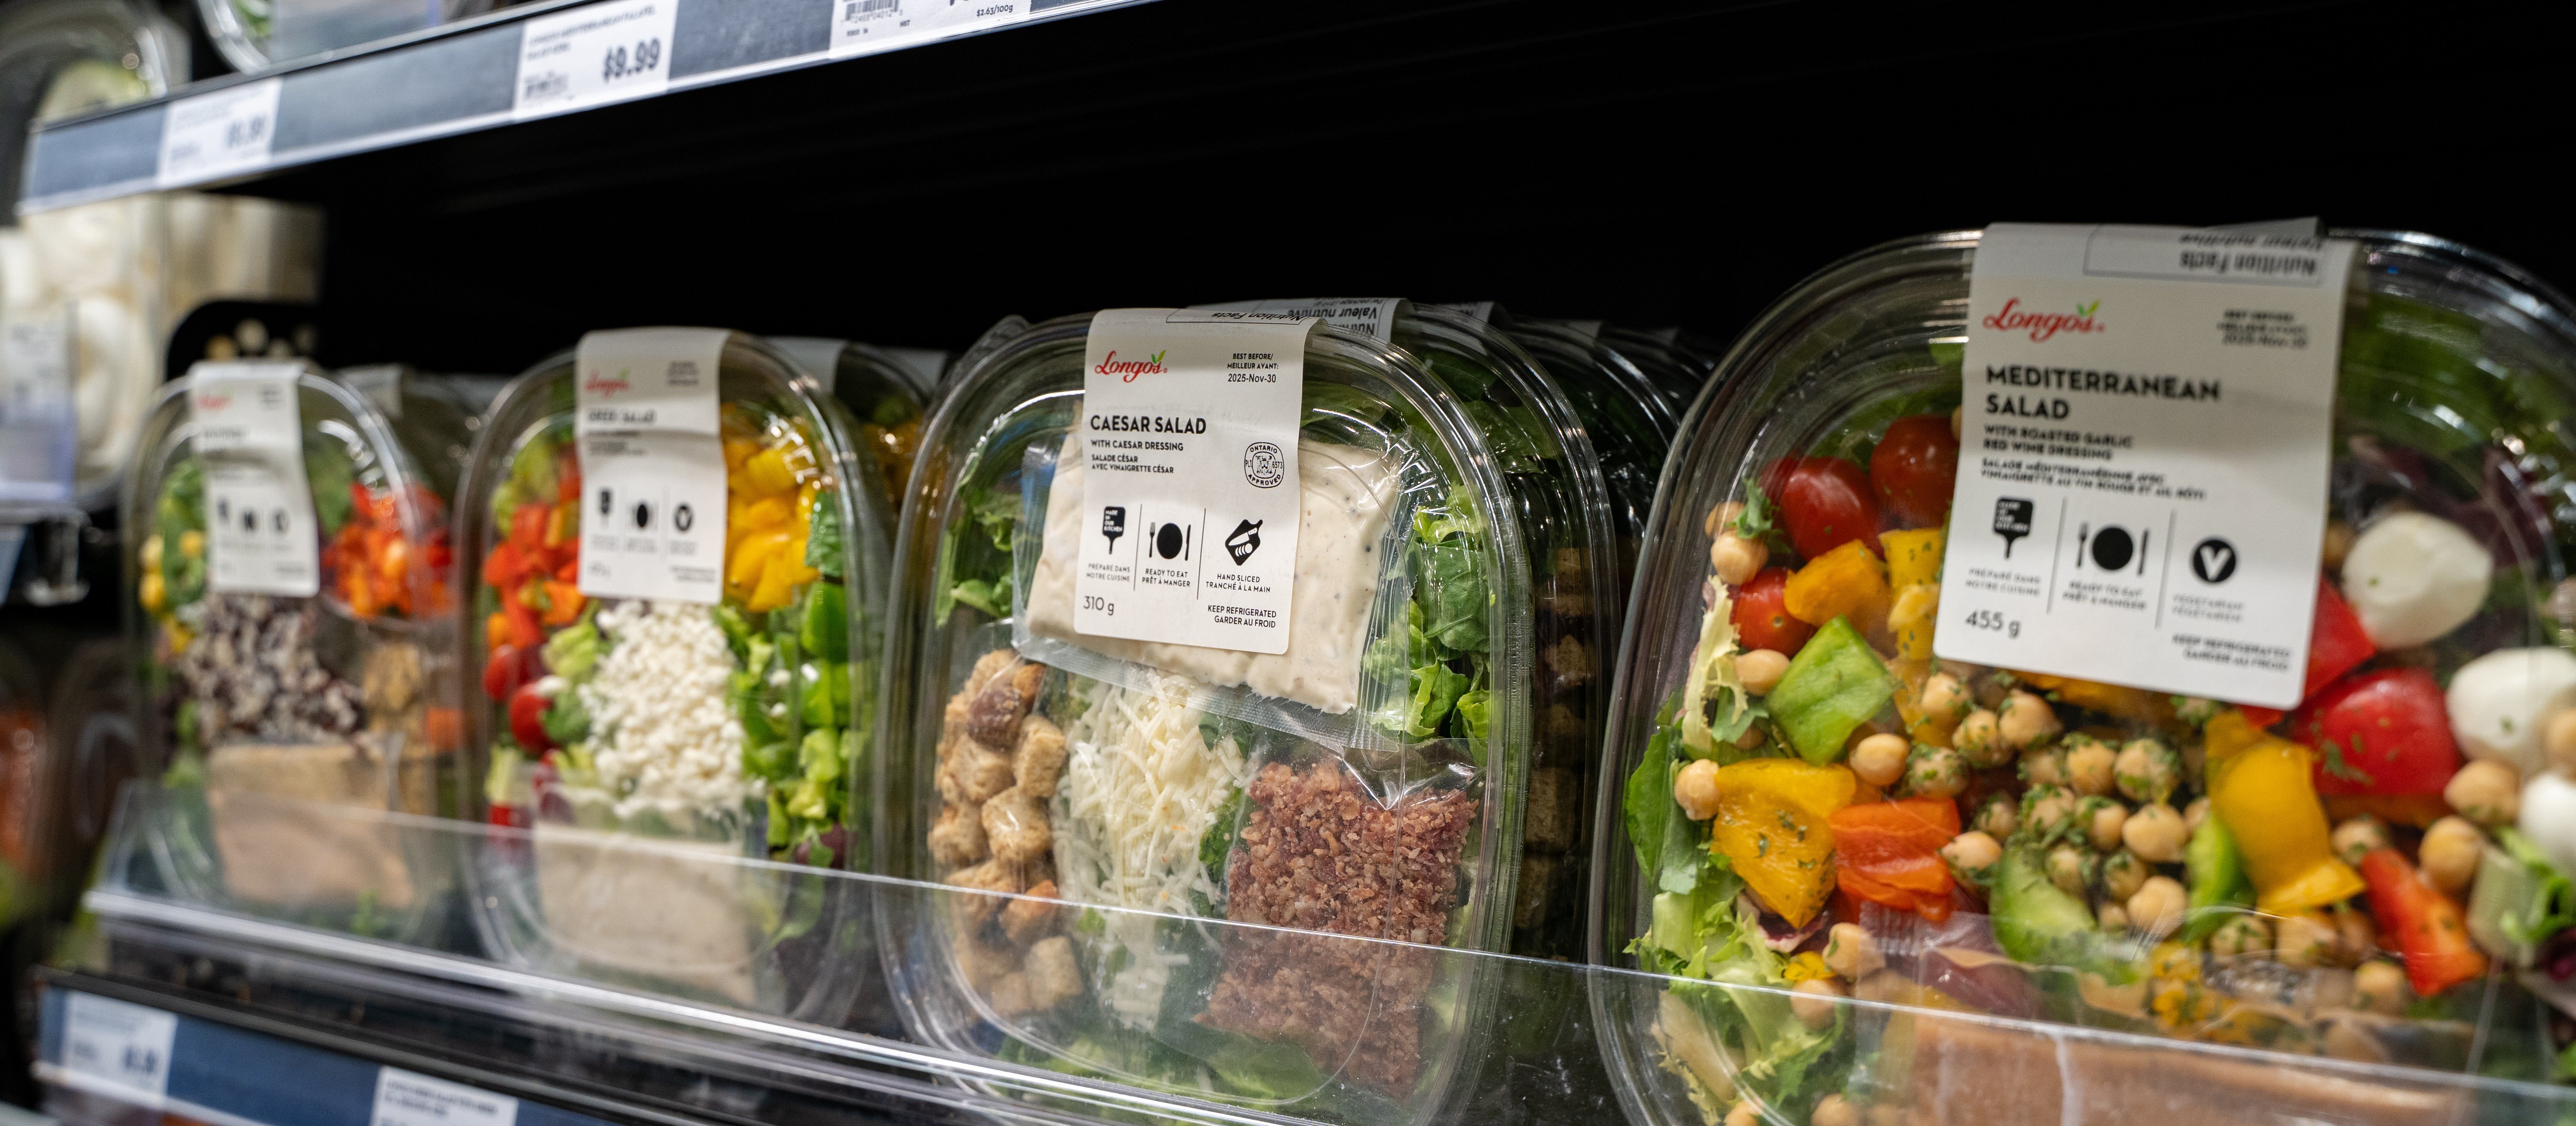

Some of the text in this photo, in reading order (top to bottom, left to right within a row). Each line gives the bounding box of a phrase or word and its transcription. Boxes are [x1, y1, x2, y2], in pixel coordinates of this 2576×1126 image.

[976, 4, 1013, 17] $2.63/100g
[604, 37, 660, 83] $9.99
[2234, 253, 2316, 275] Nutrition
[1248, 313, 1307, 321] Nutrition
[1338, 307, 1376, 319] Valeur
[1228, 373, 1276, 383] 2025-Nov-30
[1985, 364, 2222, 402] MEDITERRANEAN
[1985, 392, 2070, 420] SALAD
[1091, 415, 1207, 434] CAESAR SALAD
[1984, 424, 2017, 437] WITH
[2020, 428, 2081, 444] ROASTED
[1091, 440, 1184, 451] WITH CAESAR DRESSING
[1250, 445, 1278, 454] ONTARIO
[1983, 438, 2008, 449] RED
[2011, 441, 2044, 455] WINE
[1117, 453, 1138, 462] CÉSAR
[1110, 464, 1151, 473] VINAIGRETTE
[1153, 464, 1174, 473] CÉSAR
[1272, 461, 1282, 469] 6573
[1248, 474, 1281, 486] APPROVED
[1088, 562, 1113, 572] PRÉPARÉ
[1106, 574, 1130, 582] CUISINE
[1142, 576, 1191, 588] PRÊT À MANGER
[1237, 575, 1261, 583] SLICED
[1206, 581, 1236, 590] TRANCHÉ
[1238, 582, 1242, 591] À
[1084, 595, 1115, 616] 310 g
[1207, 604, 1276, 618] KEEP REFRIGERATED
[1214, 615, 1242, 625] GARDER
[1255, 619, 1276, 628] FROID
[1965, 609, 2022, 639] 455 g
